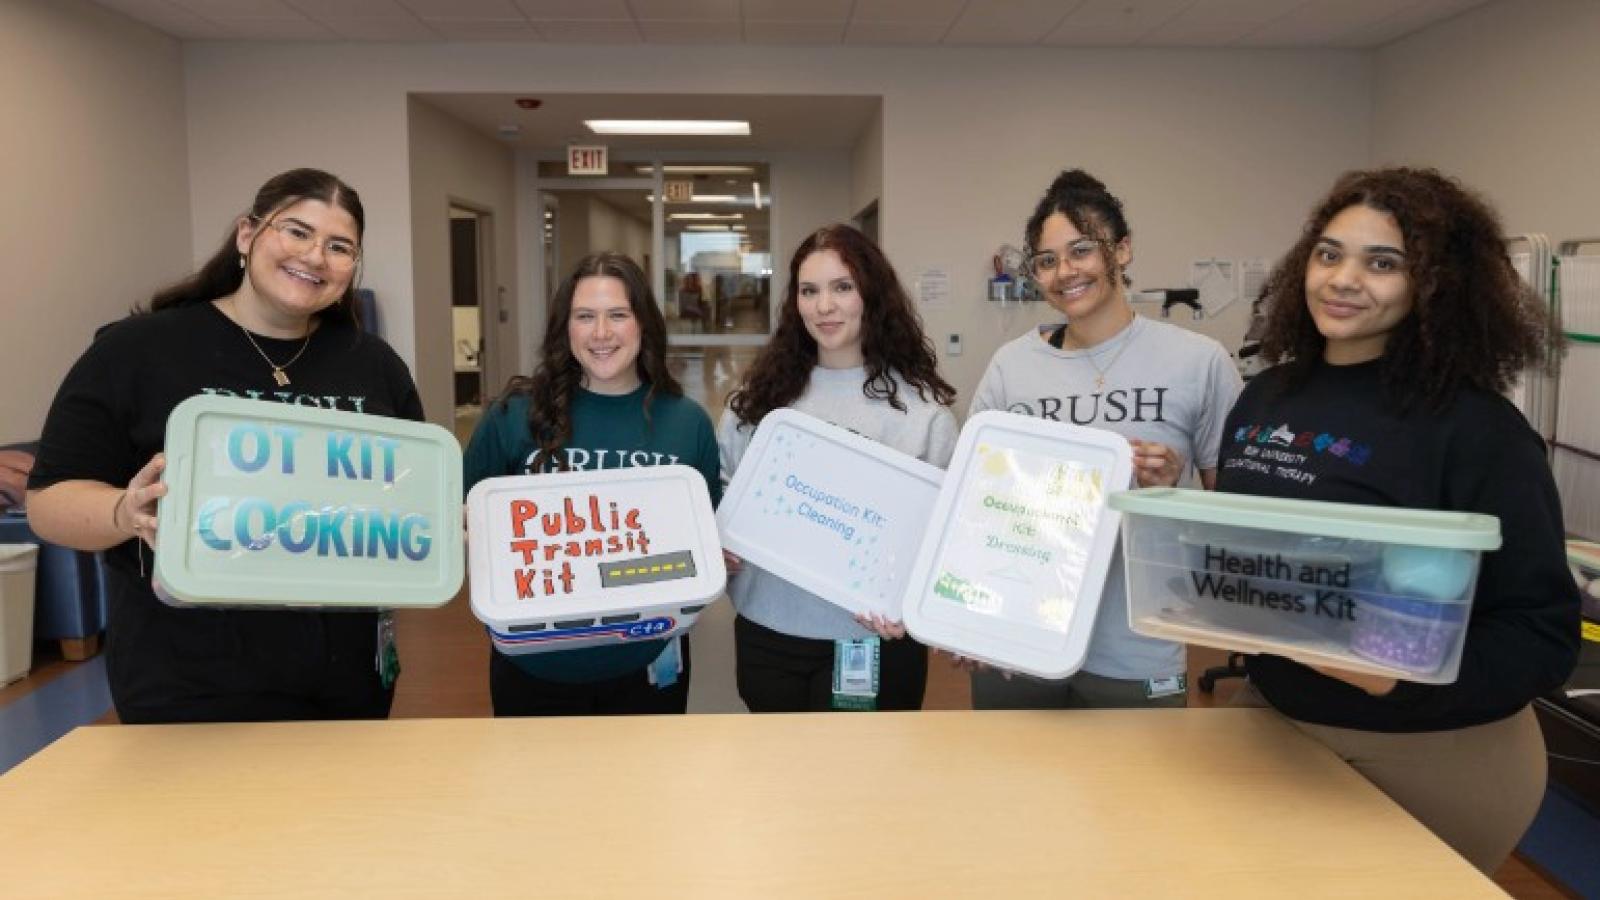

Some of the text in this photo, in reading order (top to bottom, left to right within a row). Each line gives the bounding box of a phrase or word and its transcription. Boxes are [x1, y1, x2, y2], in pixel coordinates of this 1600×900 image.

[572, 150, 603, 170] EXIT
[1038, 387, 1169, 426] RUSH
[227, 423, 400, 485] OT KIT
[510, 494, 642, 539] Public
[785, 474, 861, 519] Occupation
[197, 498, 433, 562] COOKING
[796, 502, 856, 540] Cleaning
[510, 530, 651, 566] Transit
[1204, 543, 1352, 588] Health and
[514, 561, 576, 601] Kit
[1190, 569, 1358, 622] Wellness Kit
